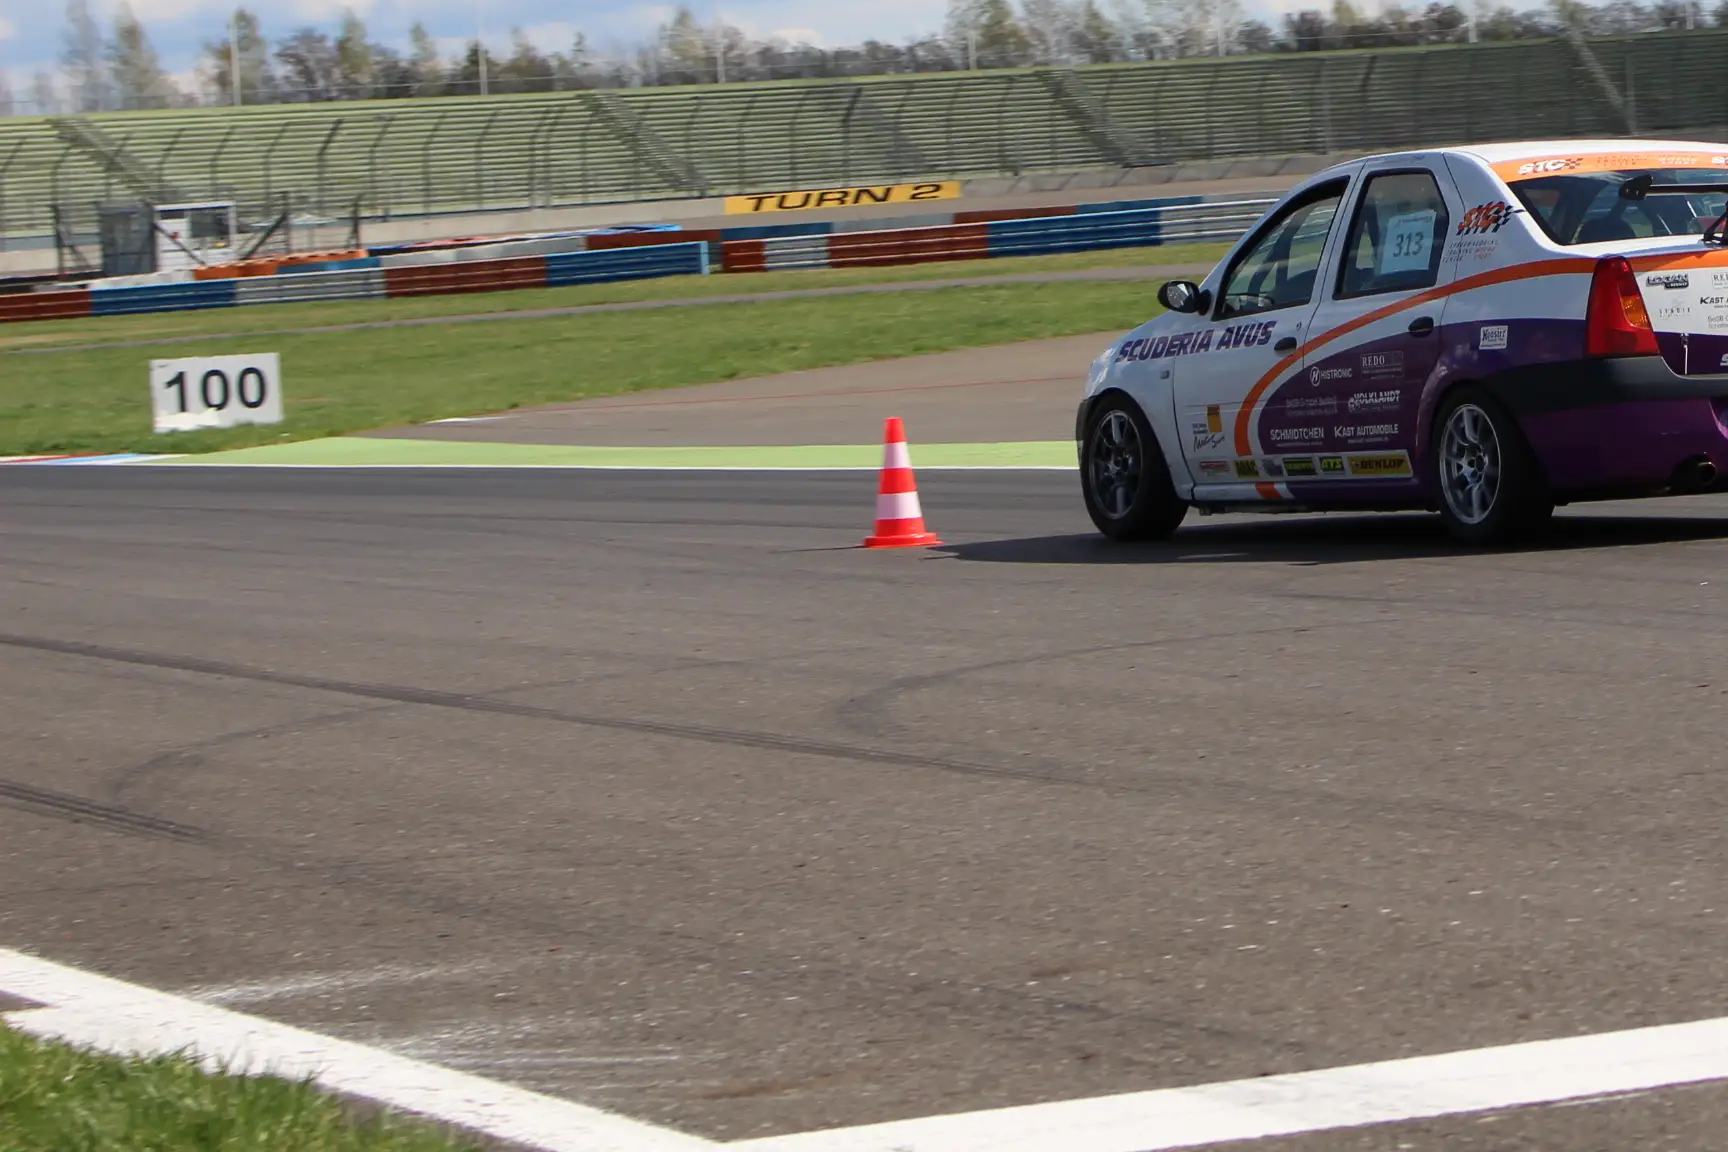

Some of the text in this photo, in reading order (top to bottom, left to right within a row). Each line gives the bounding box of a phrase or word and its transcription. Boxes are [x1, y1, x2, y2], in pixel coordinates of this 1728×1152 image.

[747, 184, 944, 211] TURN 2
[1393, 231, 1424, 258] 313
[1700, 296, 1724, 305] KAST
[1115, 321, 1277, 363] SCUDERIA AVUS
[1320, 368, 1353, 380] HISTRONIC
[164, 367, 266, 412] 100
[1270, 427, 1324, 441] SCHMIDTCHEN
[1357, 424, 1399, 436] AUTOMOBILE
[1360, 458, 1405, 469] DUNLOP
